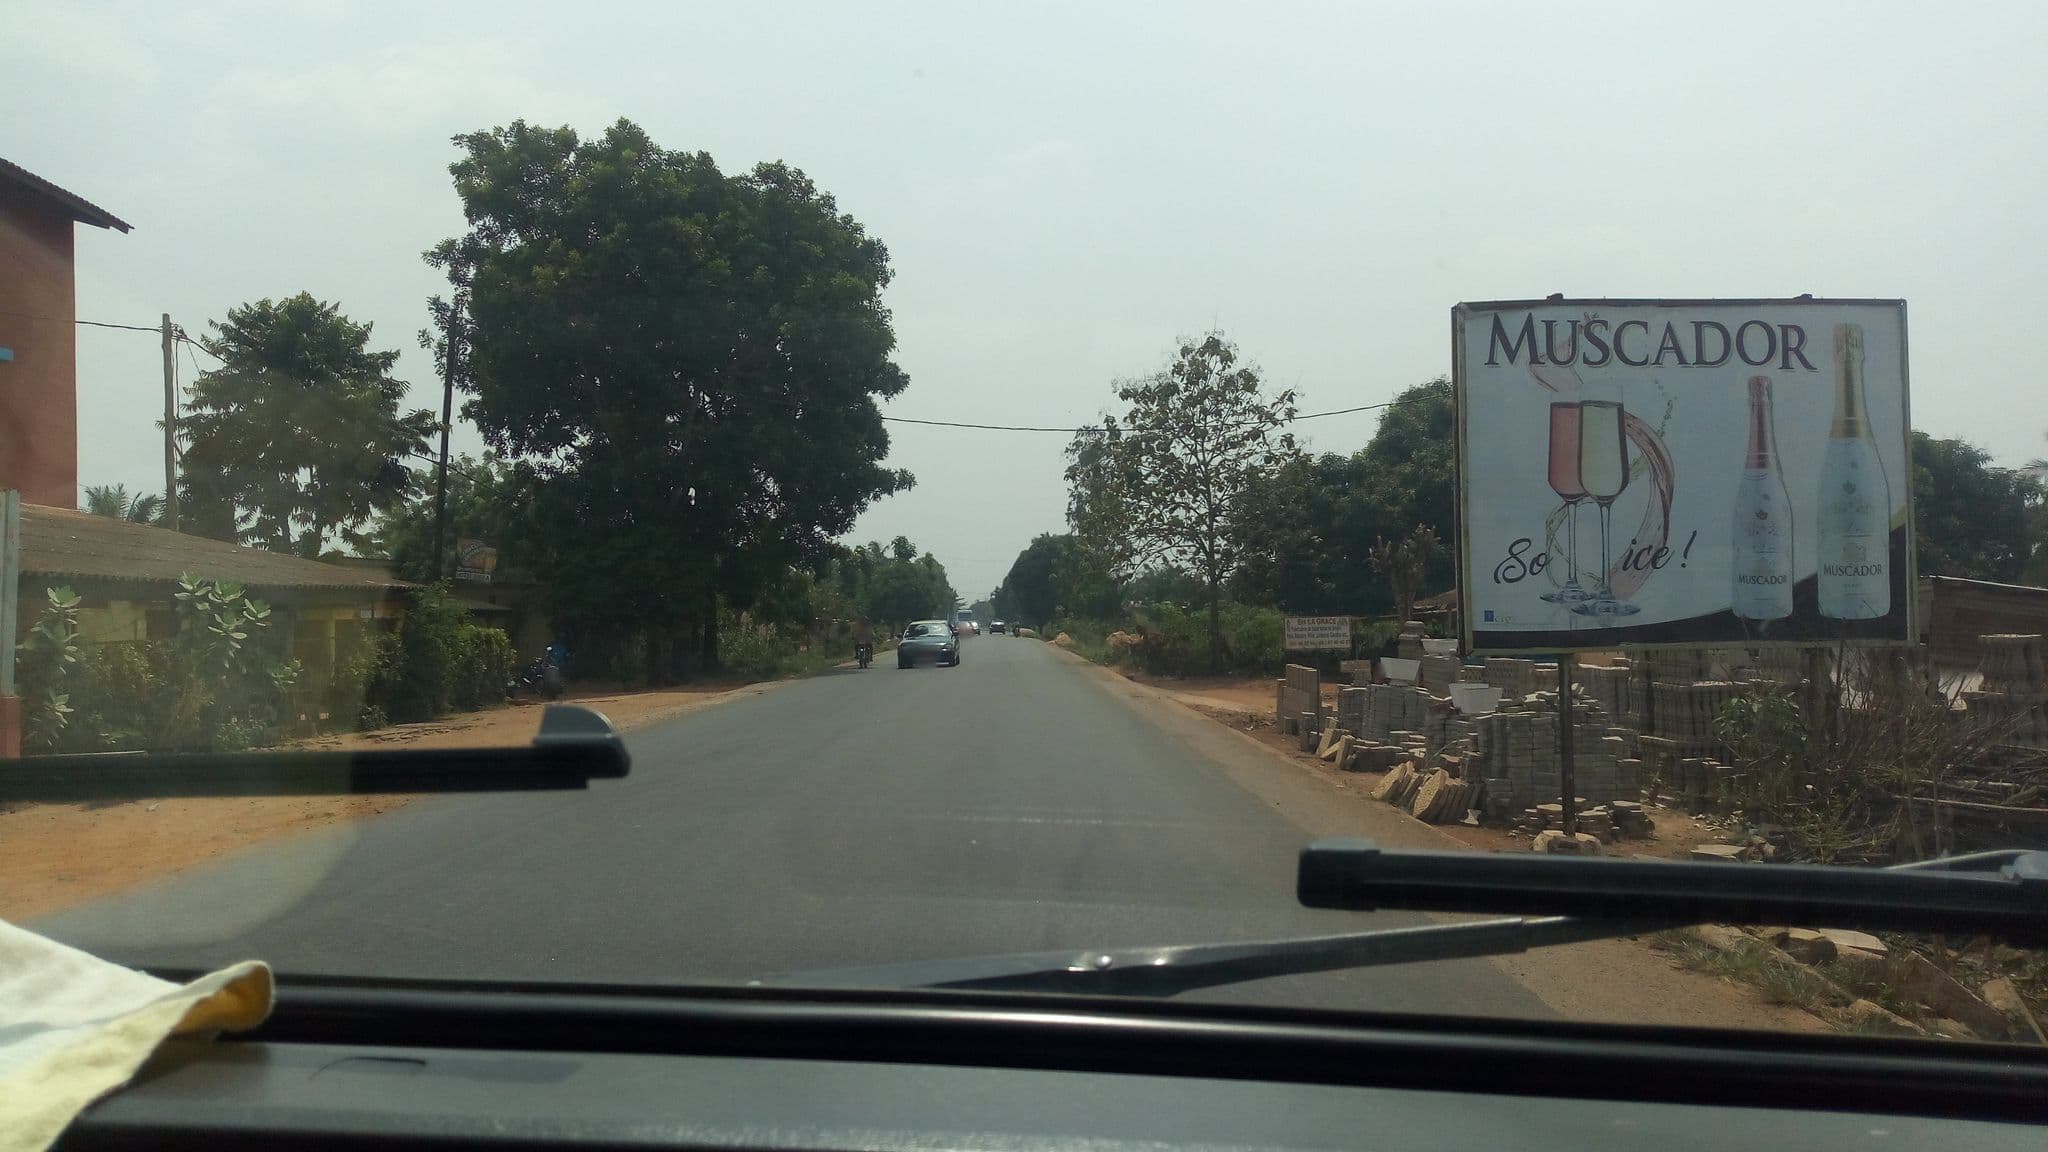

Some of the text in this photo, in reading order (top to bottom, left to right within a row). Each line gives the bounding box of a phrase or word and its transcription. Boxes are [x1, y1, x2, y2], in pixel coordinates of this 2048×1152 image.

[1484, 311, 1818, 371] MUSCADOR
[1493, 537, 1549, 584] So
[1822, 563, 1882, 577] MUSCADOR
